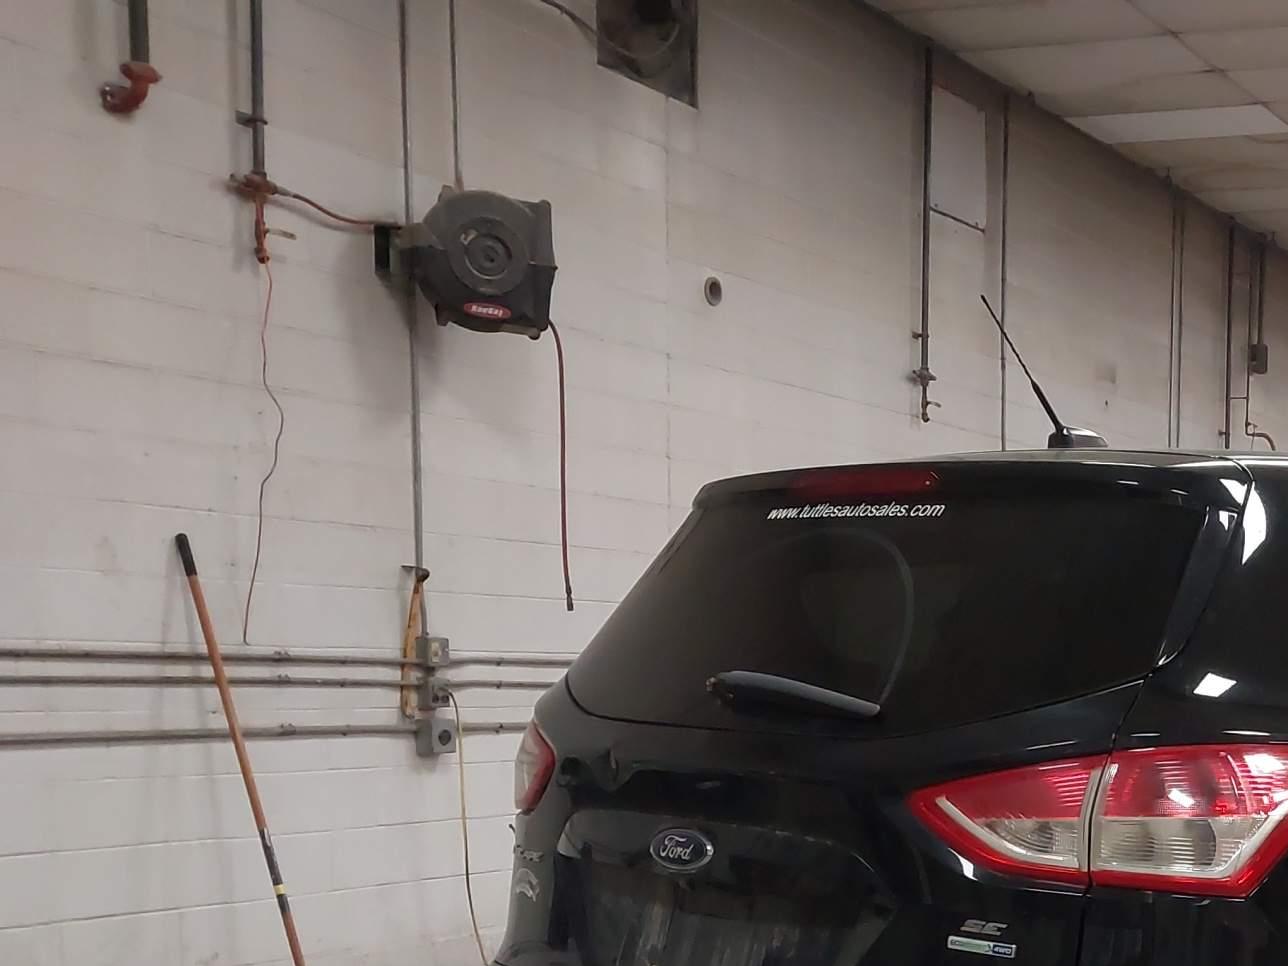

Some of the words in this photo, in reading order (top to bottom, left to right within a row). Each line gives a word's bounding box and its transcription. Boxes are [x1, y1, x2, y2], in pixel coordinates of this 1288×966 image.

[767, 502, 946, 520] www.tuttlesautosales.com
[660, 834, 695, 860] Ford
[960, 919, 1008, 936] SE
